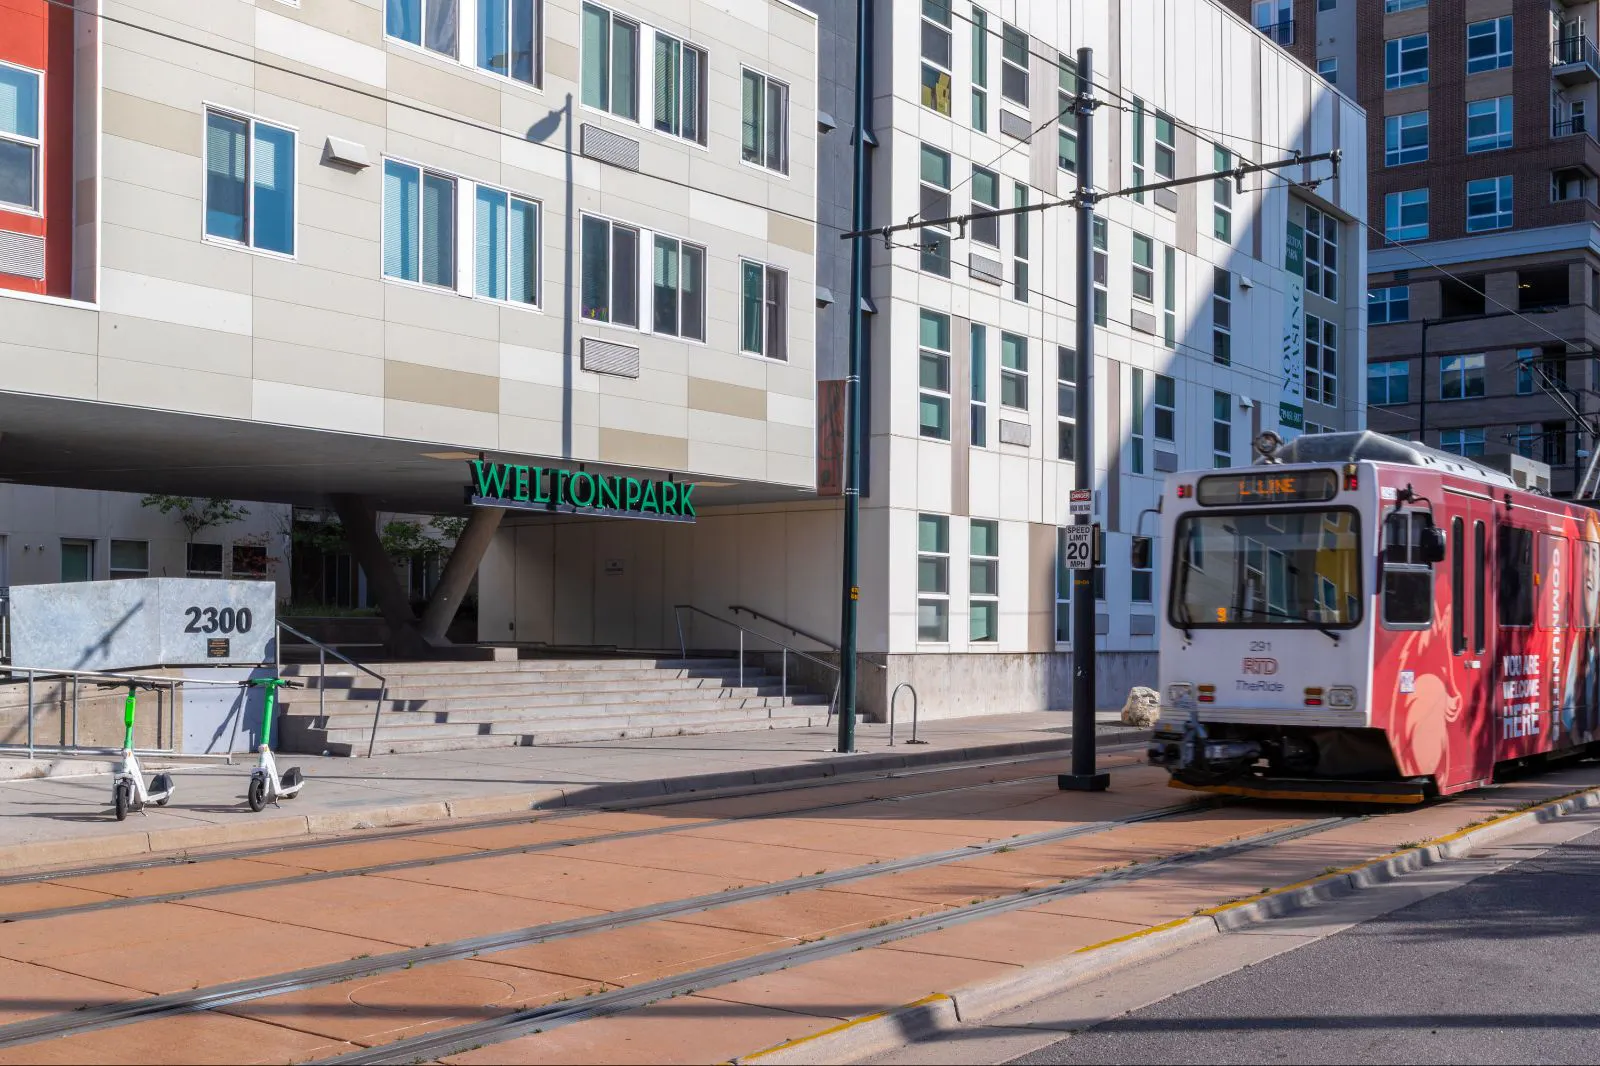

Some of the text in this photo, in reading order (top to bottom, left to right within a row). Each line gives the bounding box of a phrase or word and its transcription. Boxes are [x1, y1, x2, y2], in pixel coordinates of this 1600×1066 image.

[1292, 284, 1300, 395] LEASING
[1239, 478, 1297, 495] L LINE
[1067, 526, 1091, 534] SPEED
[1069, 534, 1088, 542] LIMIT
[1067, 542, 1090, 560] 20
[1070, 560, 1086, 568] MPH
[184, 606, 253, 634] 2300
[1249, 641, 1272, 652] 291
[1242, 657, 1279, 675] RTD
[1503, 654, 1540, 677] YOU ARE
[1235, 680, 1285, 692] TheRide
[1503, 679, 1540, 700] WELCOME
[1503, 702, 1540, 740] HERE
